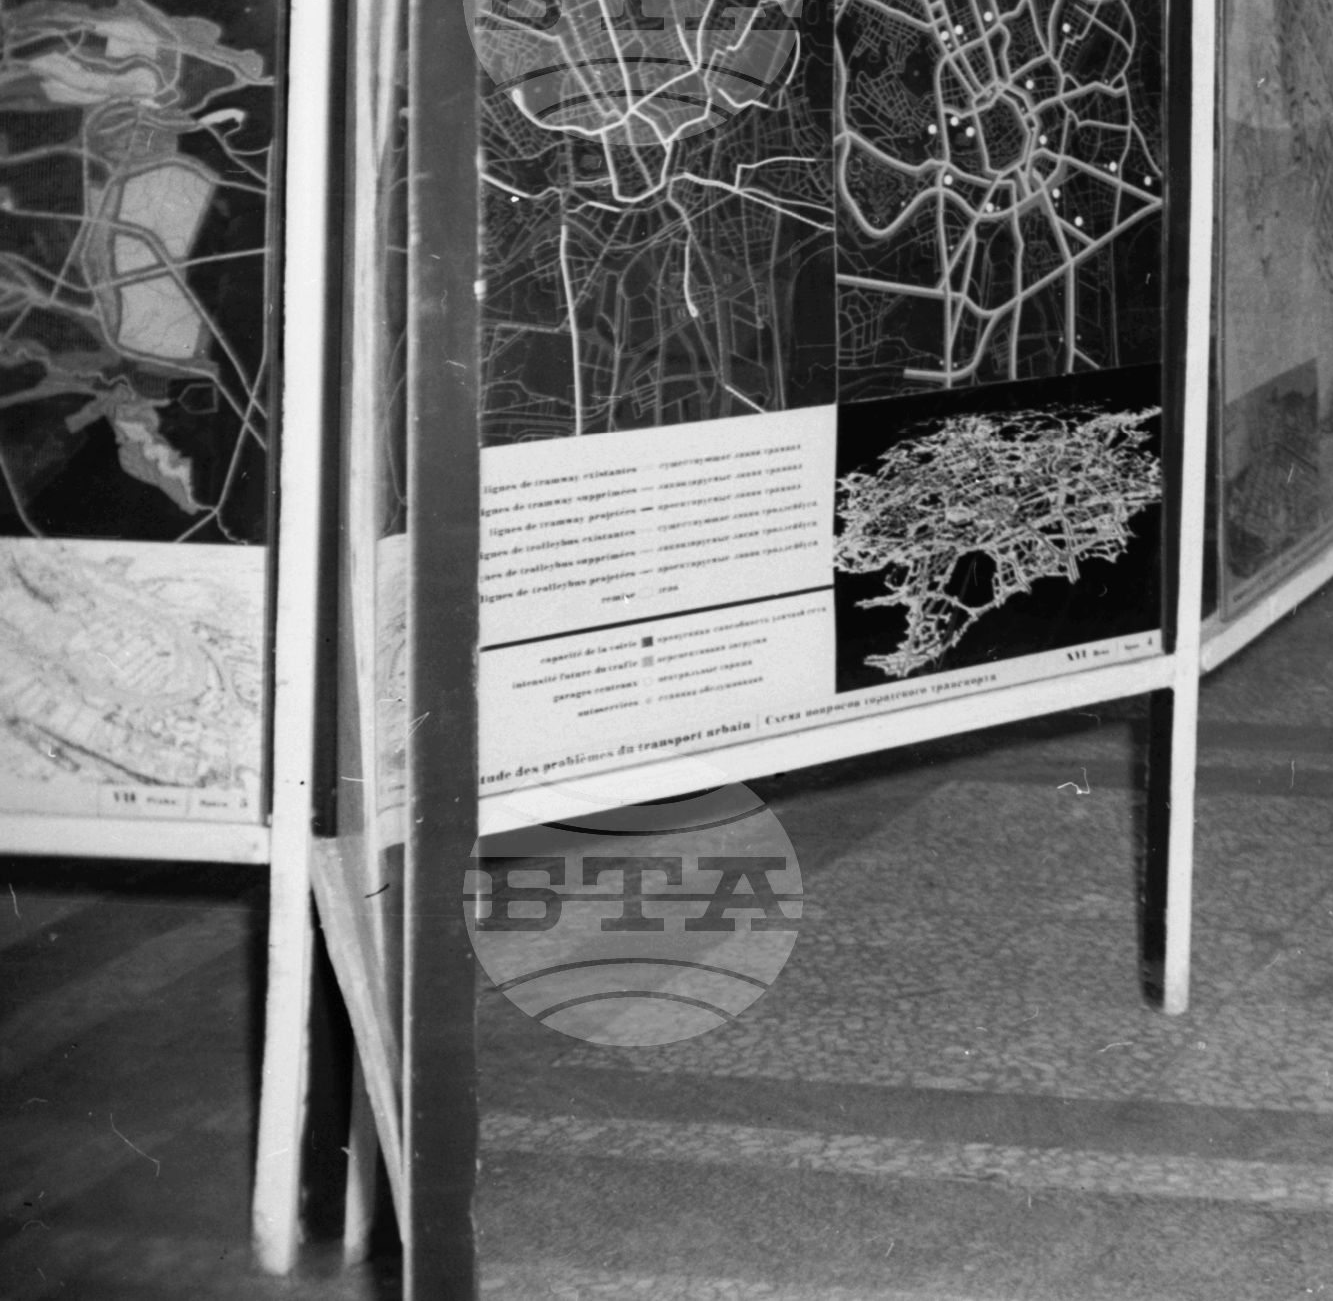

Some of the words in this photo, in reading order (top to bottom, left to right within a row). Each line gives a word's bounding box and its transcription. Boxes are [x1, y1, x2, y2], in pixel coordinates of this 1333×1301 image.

[484, 483, 516, 494] lignes
[520, 480, 531, 488] de
[534, 475, 578, 486] tramway
[582, 467, 637, 479] existantes
[513, 503, 523, 511] de
[527, 497, 571, 508] tramway
[489, 525, 522, 537] lignes
[525, 522, 536, 530] de
[539, 516, 583, 527] tramway
[511, 546, 522, 554] de
[582, 530, 635, 542] existantes
[506, 569, 516, 577] de
[516, 588, 527, 596] de
[512, 675, 556, 688] intensité
[553, 689, 591, 703] garages
[479, 770, 511, 785] tude
[515, 765, 538, 776] des
[542, 750, 612, 773] problèmes
[618, 744, 634, 755] du
[638, 731, 701, 750] transport
[707, 721, 750, 737] urbain
